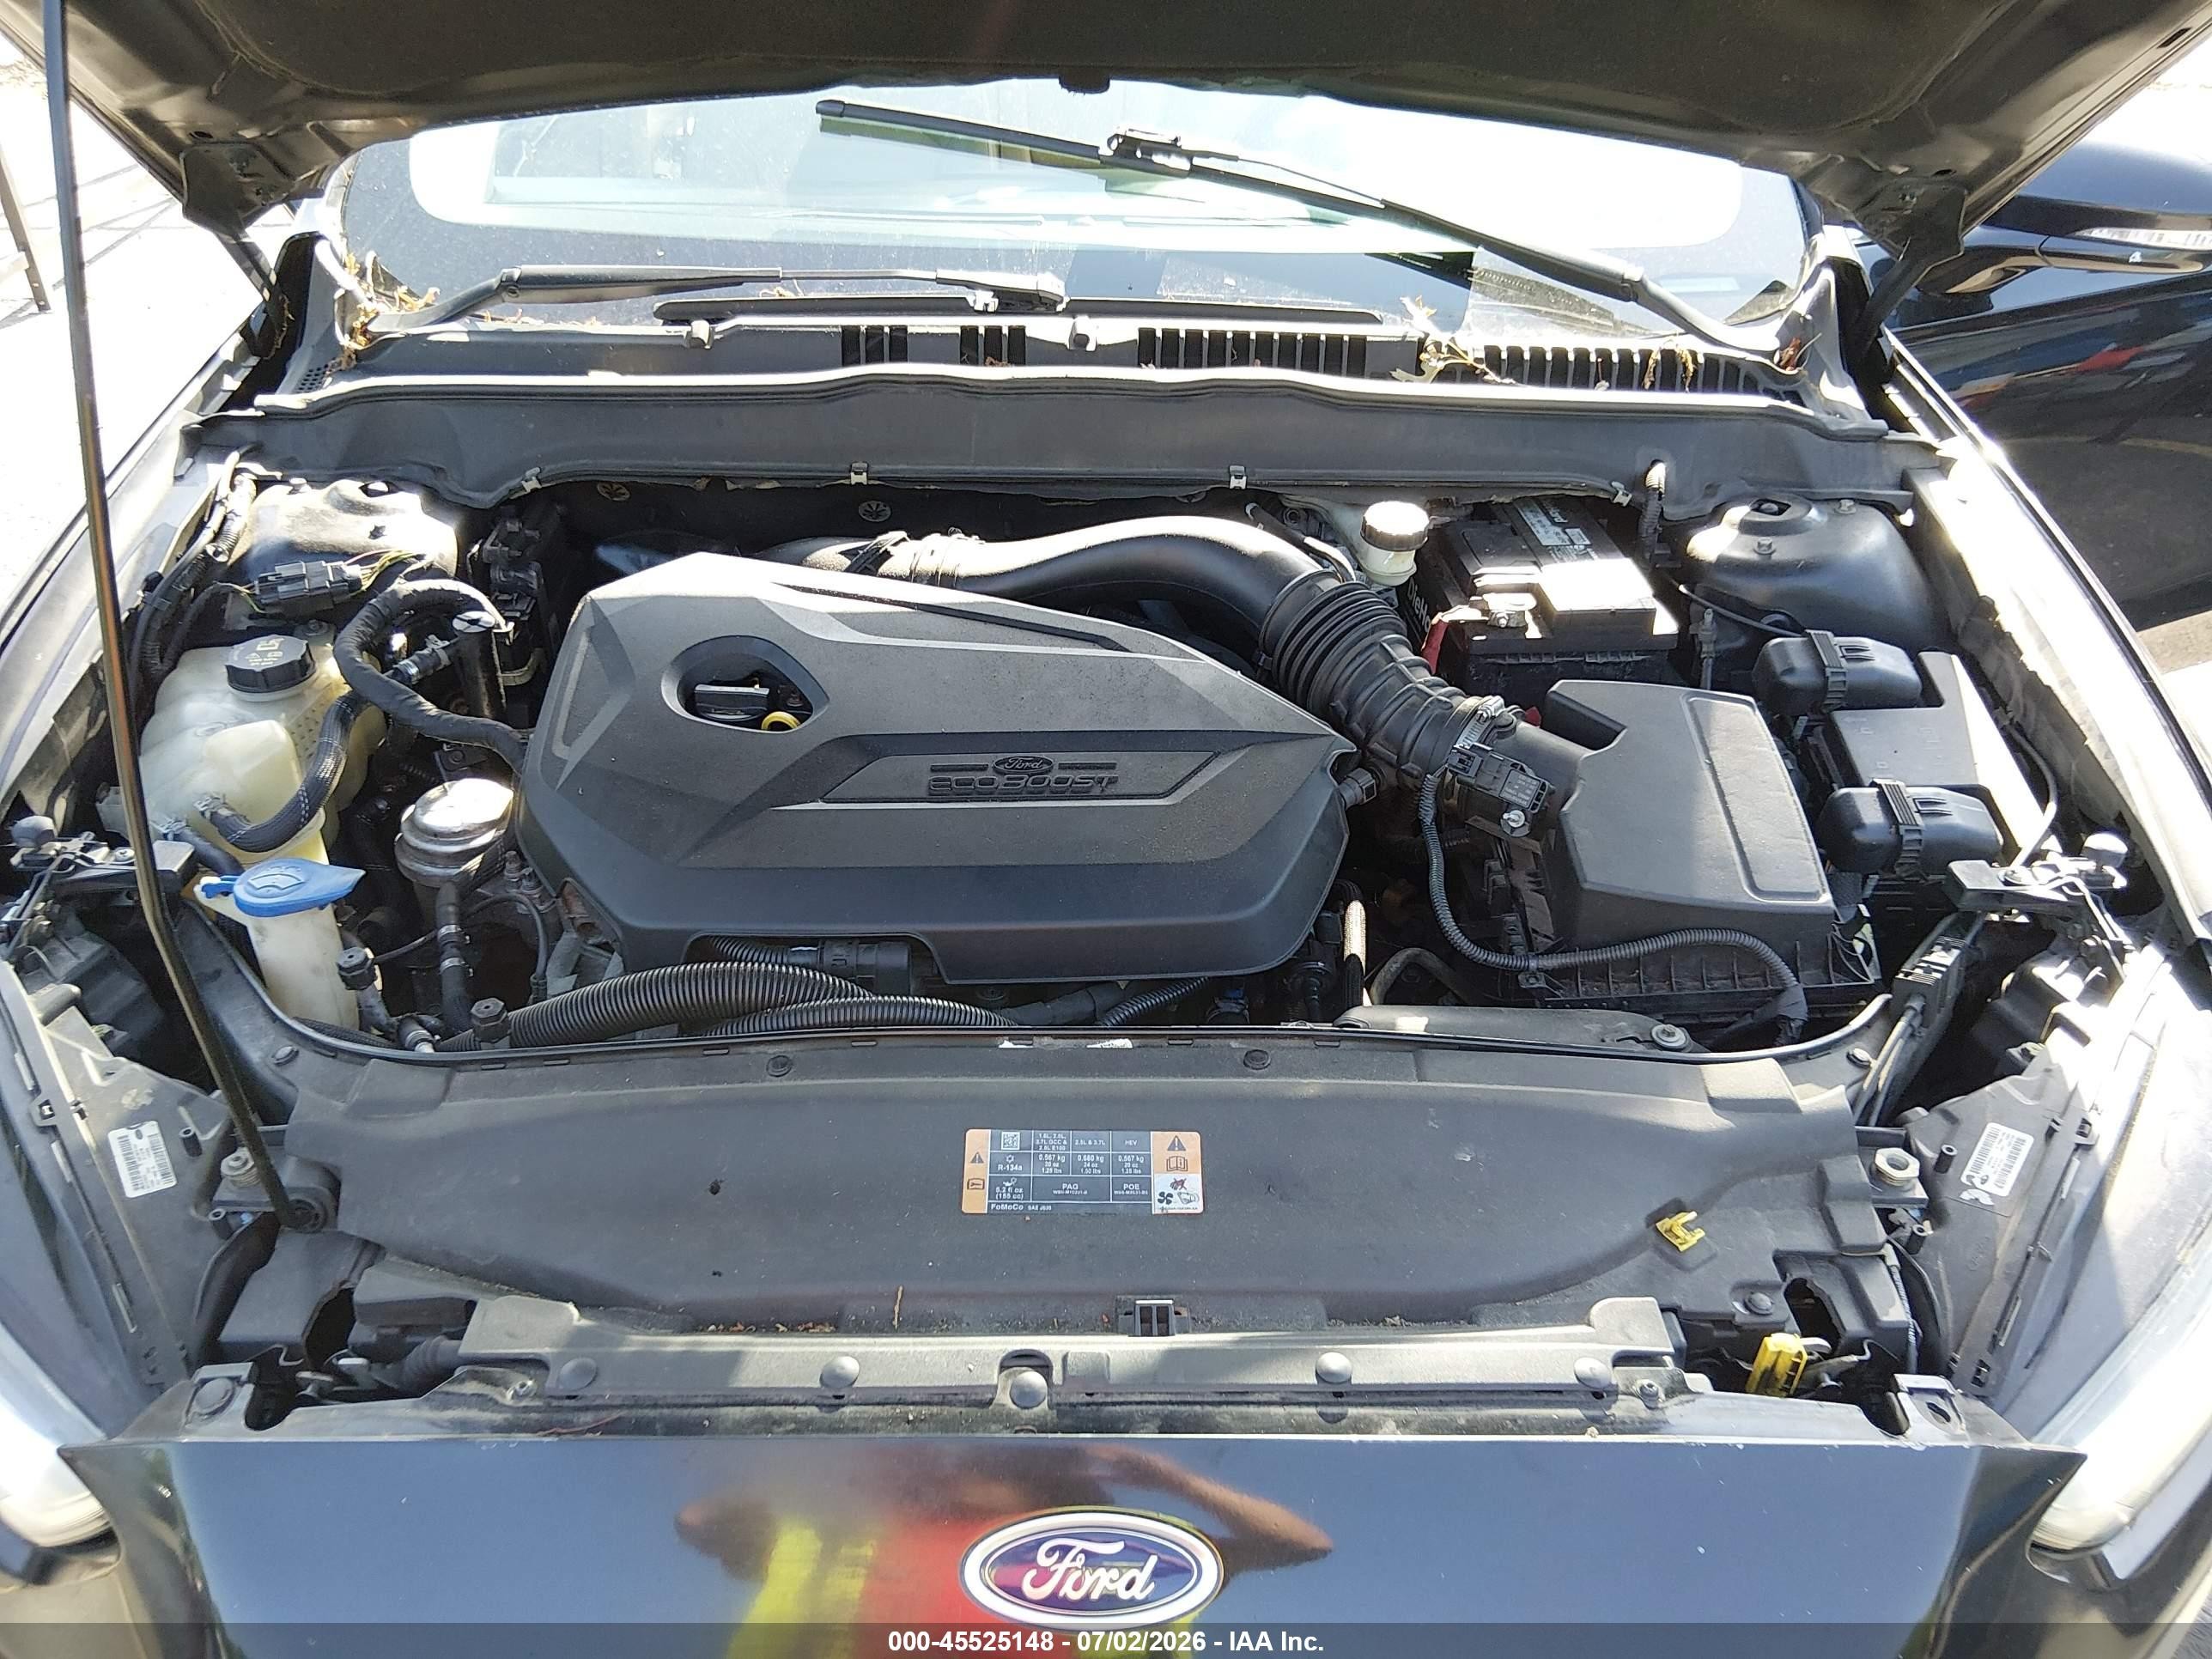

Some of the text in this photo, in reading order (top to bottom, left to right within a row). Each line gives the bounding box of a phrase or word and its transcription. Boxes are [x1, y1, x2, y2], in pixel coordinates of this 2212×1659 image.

[1407, 576, 1431, 634] DieHa
[1004, 757, 1043, 770] Ford
[1057, 1153, 1066, 1163] kg
[1096, 1154, 1104, 1163] kg
[1136, 1155, 1145, 1164] kg
[1022, 1538, 1158, 1601] Ford
